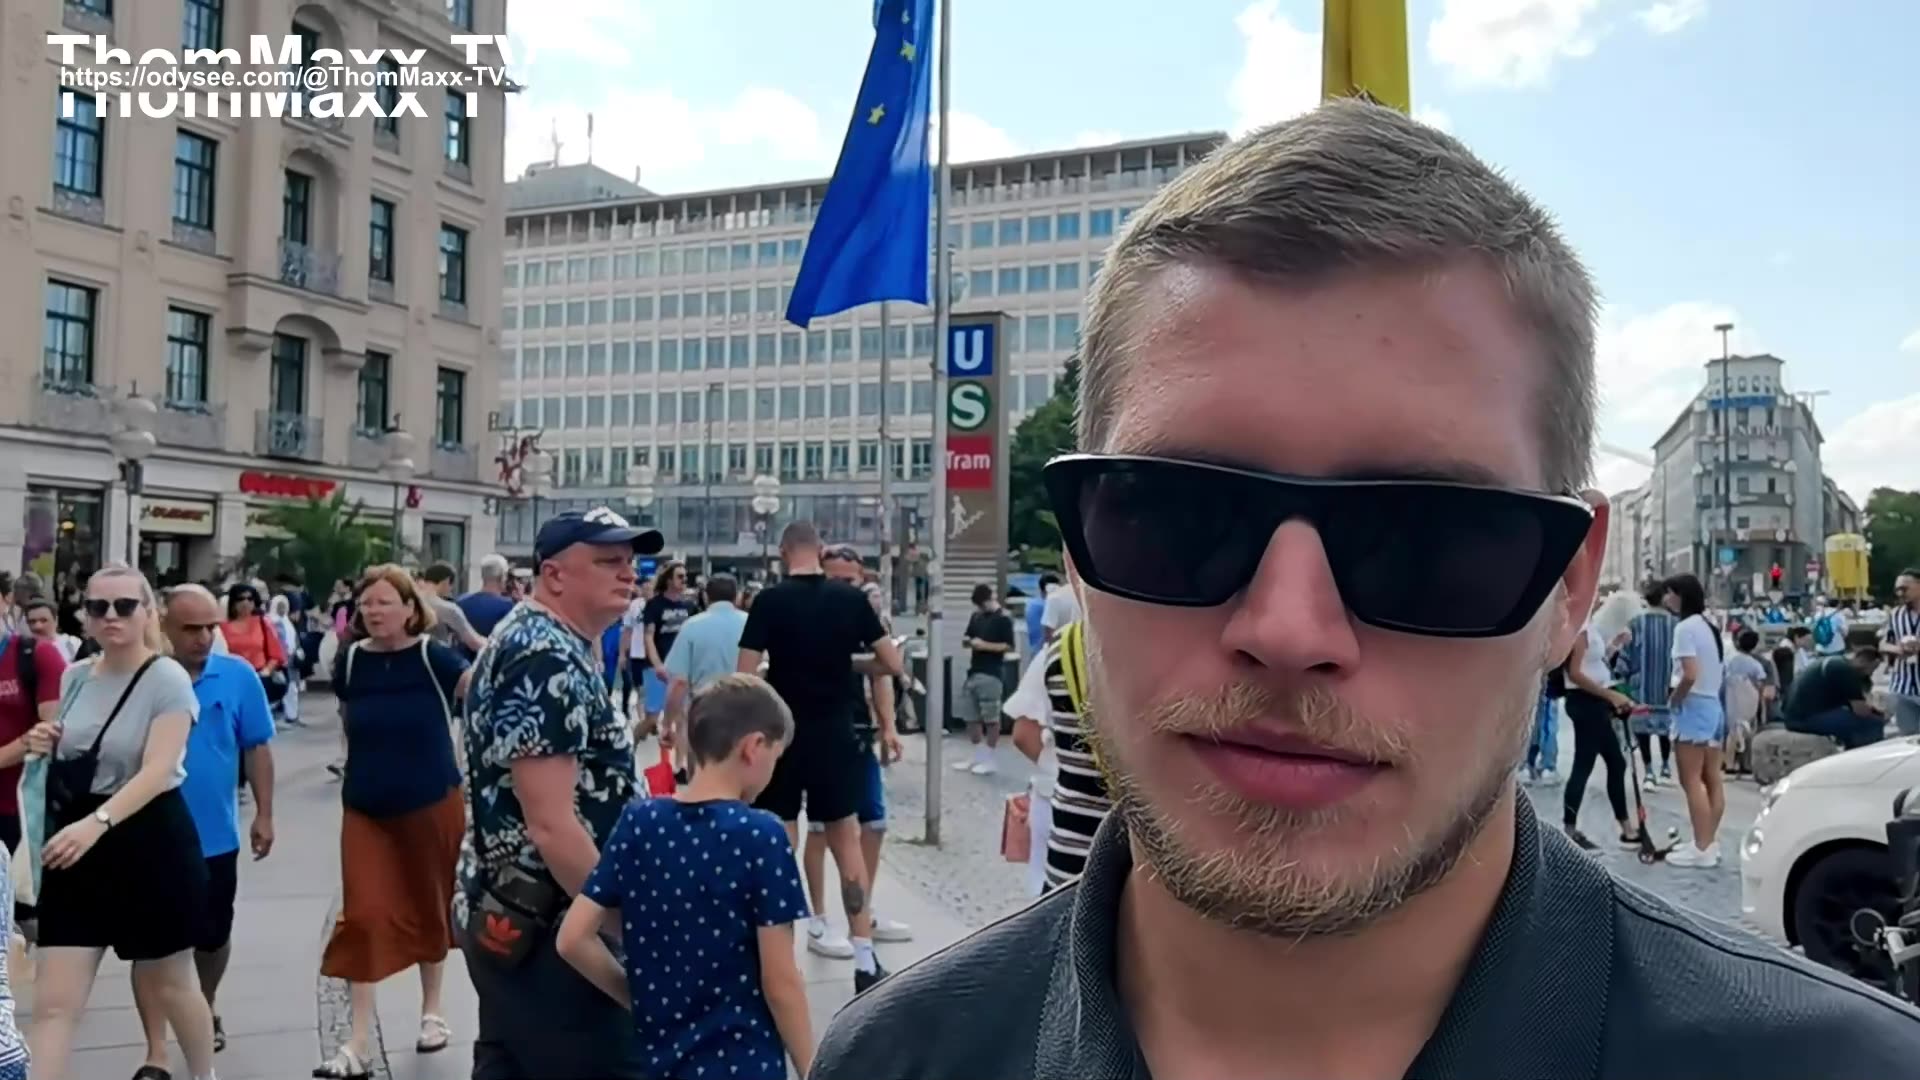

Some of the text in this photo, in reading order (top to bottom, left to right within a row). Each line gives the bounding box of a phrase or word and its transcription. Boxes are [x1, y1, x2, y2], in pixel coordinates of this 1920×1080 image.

[953, 330, 985, 371] U
[951, 384, 986, 428] S
[947, 450, 991, 470] Tram
